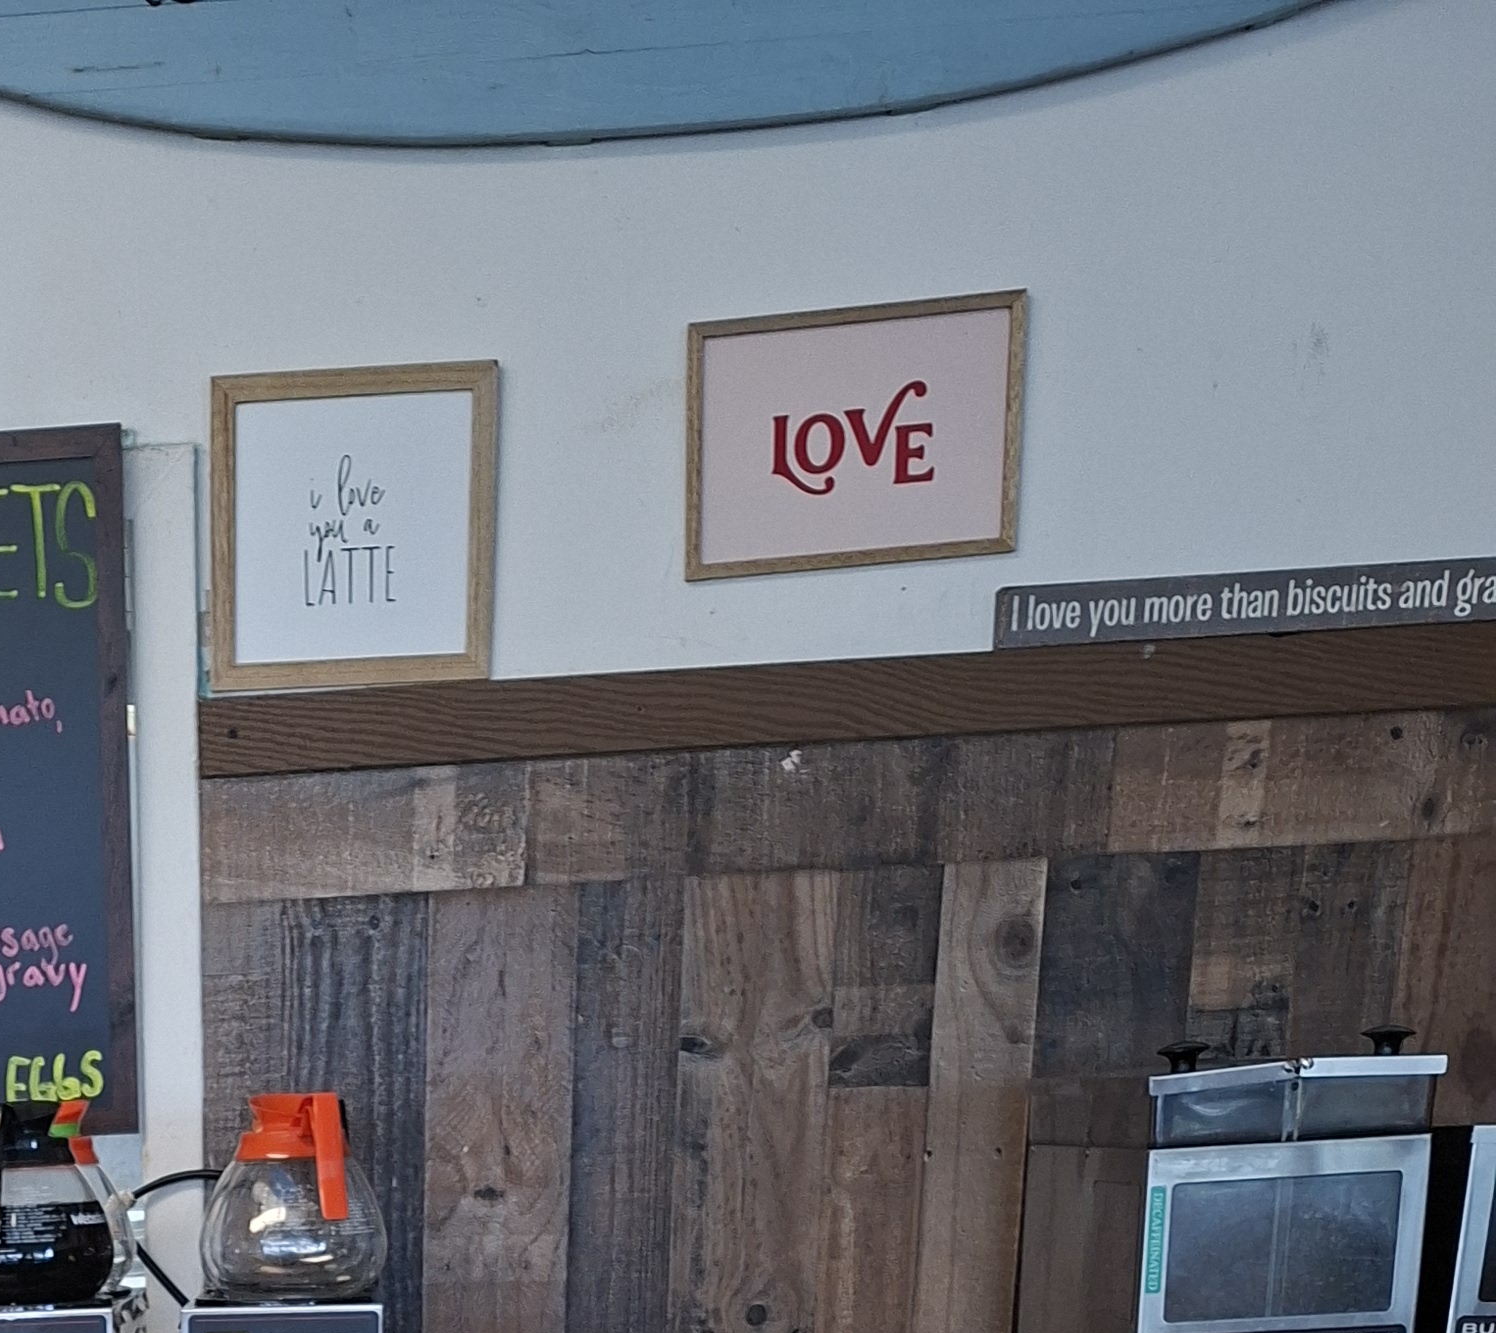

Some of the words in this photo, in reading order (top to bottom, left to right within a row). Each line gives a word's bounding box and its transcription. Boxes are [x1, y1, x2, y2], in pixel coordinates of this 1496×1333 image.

[772, 380, 934, 495] LOVE
[337, 455, 385, 515] love
[309, 519, 348, 562] you
[363, 518, 381, 535] a
[304, 546, 396, 606] LATTE
[1010, 595, 1020, 632] I
[1026, 594, 1081, 630] love
[1089, 597, 1136, 638] you
[1143, 595, 1213, 624] more
[1220, 583, 1279, 621] than
[1286, 576, 1393, 617] biscuits
[1398, 569, 1451, 608] and
[5, 1050, 104, 1103] EGGS
[1148, 1192, 1164, 1291] DECAFFEINATED
